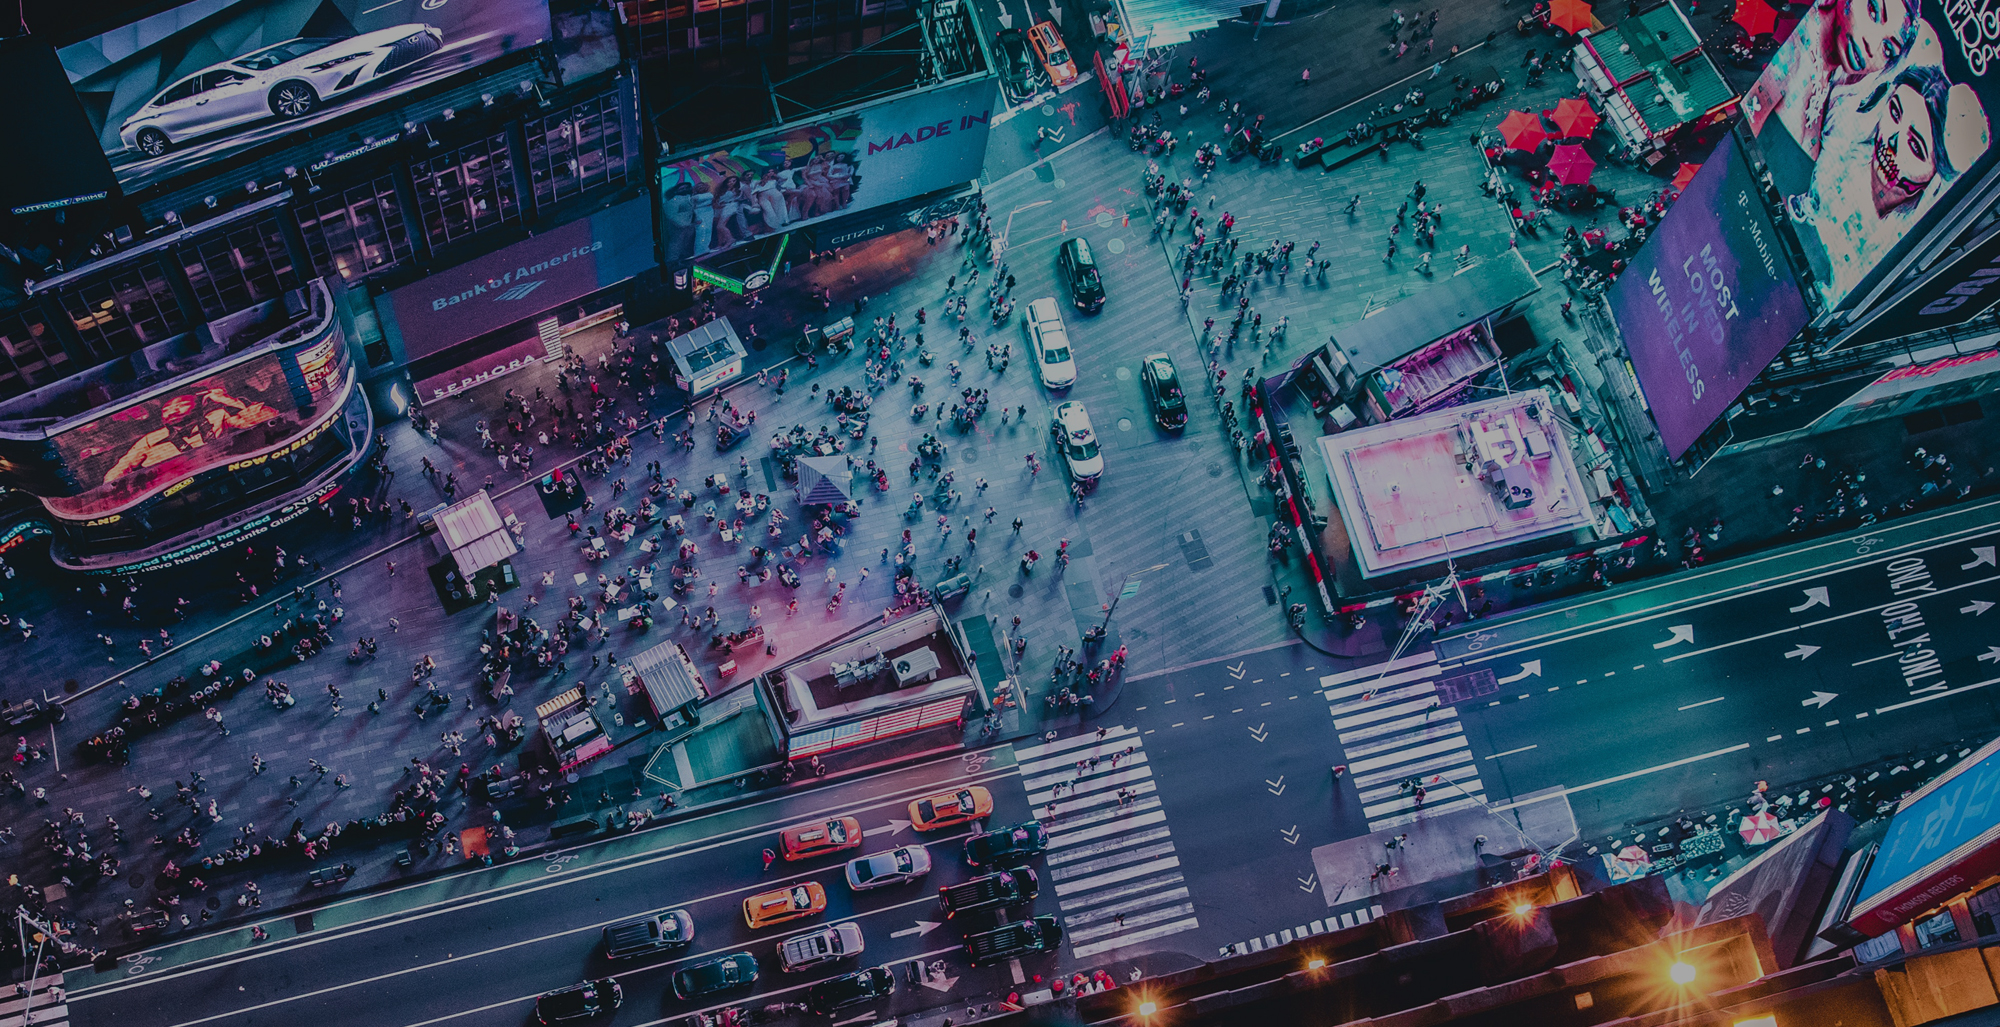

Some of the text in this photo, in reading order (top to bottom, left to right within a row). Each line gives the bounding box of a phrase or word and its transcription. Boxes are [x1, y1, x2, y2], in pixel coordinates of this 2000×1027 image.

[868, 110, 989, 156] MADE IN
[15, 193, 104, 213] OUTFRONT PRIME
[831, 224, 885, 244] CITIZEN
[432, 241, 603, 312] Bank of America
[1700, 242, 1739, 321] MOST
[1681, 301, 1699, 334] IN
[1683, 255, 1725, 345] LOVED
[1648, 267, 1705, 404] WIRELESS.
[434, 354, 535, 398] SEPHORA
[228, 454, 268, 471] NOW
[271, 447, 289, 460] ON
[294, 481, 337, 510] NEWS
[0, 521, 32, 544] actor
[86, 514, 121, 527] AND
[220, 541, 235, 549] to
[270, 506, 310, 528] Giants
[116, 557, 160, 574] played
[217, 528, 241, 541] has
[243, 515, 271, 530] died
[1886, 557, 1937, 596] ONLY
[1880, 602, 1931, 648] ONLY
[1898, 649, 1949, 696] ONLY
[1893, 874, 1965, 914] THOMSON REUTERS
